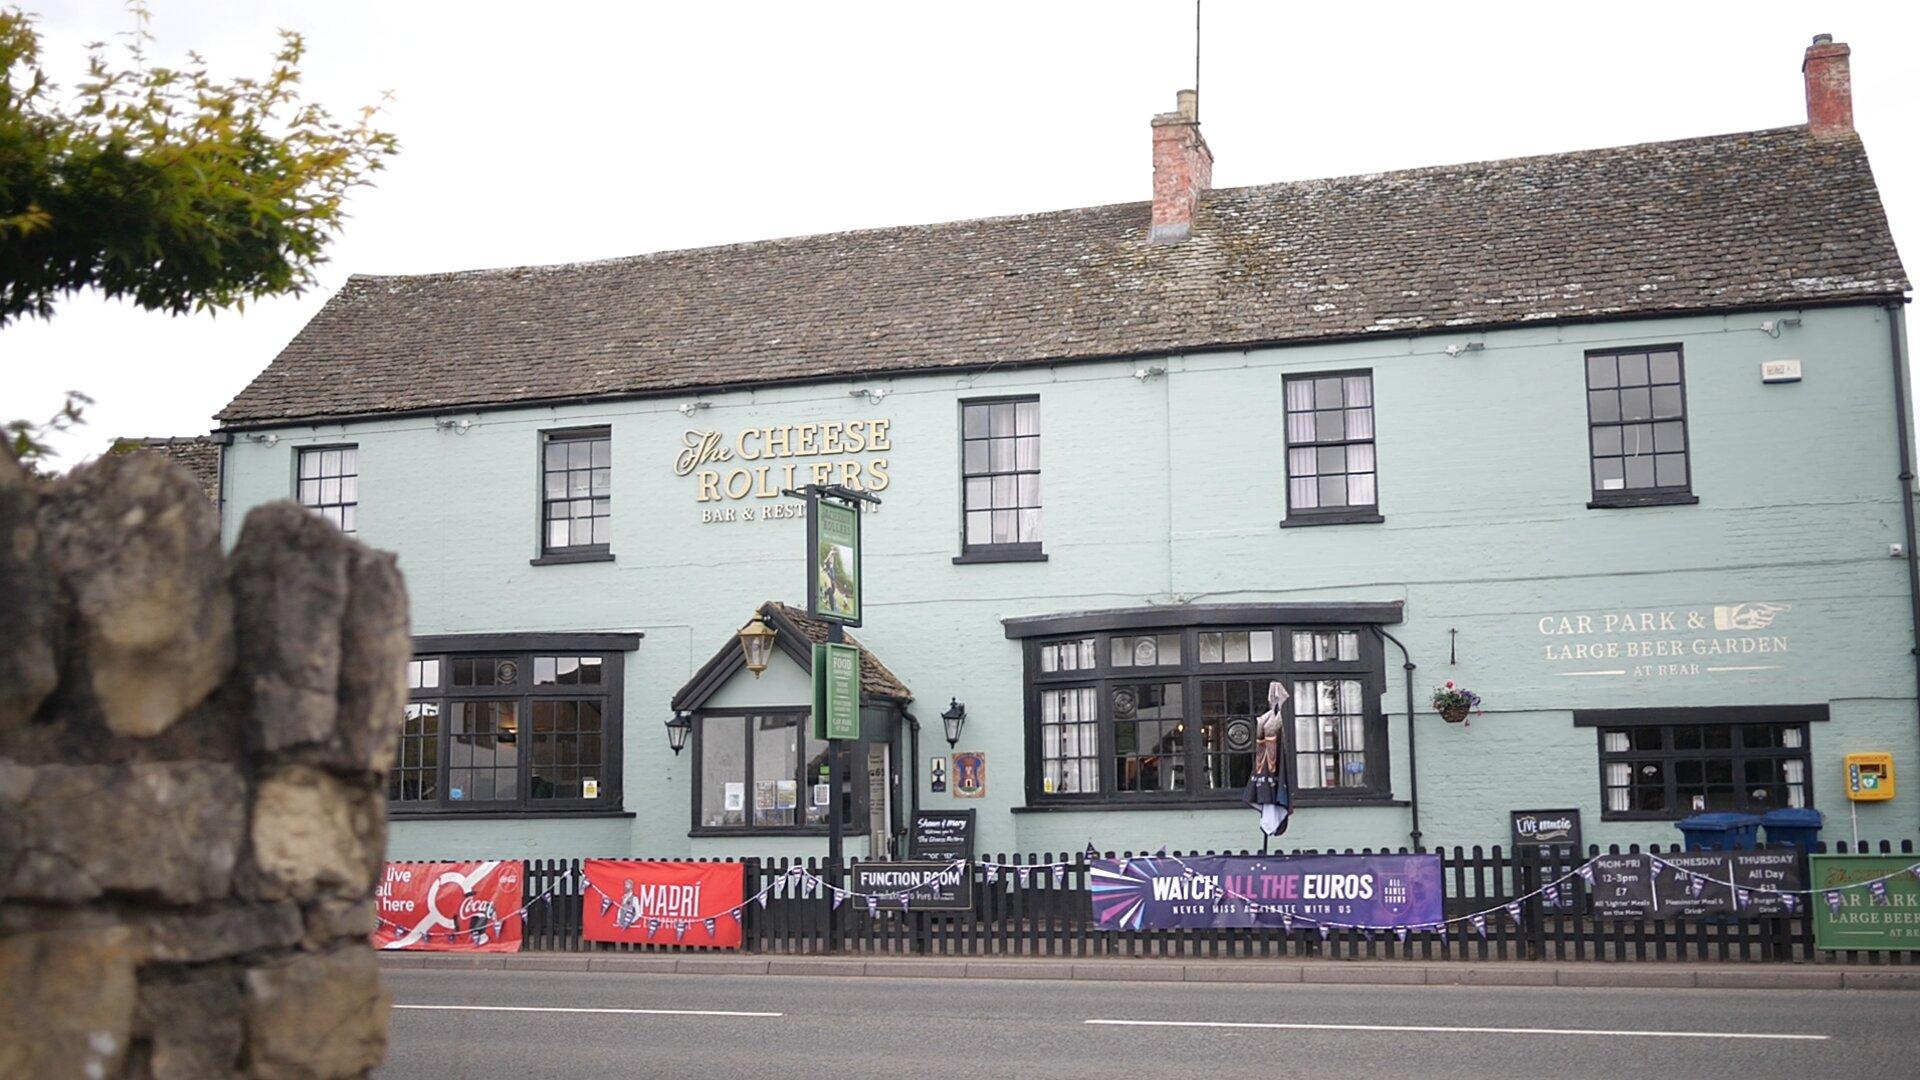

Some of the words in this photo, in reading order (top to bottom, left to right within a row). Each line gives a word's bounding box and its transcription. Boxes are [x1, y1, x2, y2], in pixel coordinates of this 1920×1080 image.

[673, 429, 734, 476] The
[735, 418, 891, 461] CHEESE
[696, 457, 890, 503] ROLLERS
[701, 508, 736, 524] BAR
[743, 507, 754, 521] &
[1538, 613, 1593, 635] CAR
[1603, 611, 1676, 633] PARK
[1687, 610, 1706, 630] &
[1544, 642, 1619, 661] LARGE
[1627, 640, 1685, 658] BEER
[1691, 636, 1789, 656] GARDEN
[833, 657, 852, 670] FOOD
[1633, 665, 1653, 676] AT
[1658, 664, 1701, 676] REAR
[1516, 818, 1537, 834] LIVE
[1597, 859, 1641, 869] MON-FRI
[1737, 855, 1794, 865] THURSDAY
[387, 867, 412, 883] live
[860, 871, 921, 886] FUNCTION
[1602, 873, 1639, 884] 12-3pm
[1748, 870, 1762, 879] All
[1765, 869, 1785, 880] Day
[1152, 875, 1219, 901] WATCH
[1224, 874, 1258, 900] ALL
[1260, 874, 1299, 900] THE
[1303, 873, 1374, 900] EUROS
[383, 897, 415, 912] here
[1824, 894, 1862, 907] AR
[1173, 905, 1205, 914] NEVER
[1212, 905, 1236, 914] MISS
[1304, 905, 1330, 913] WITH
[1339, 905, 1352, 914] US
[1829, 912, 1879, 924] LARGE
